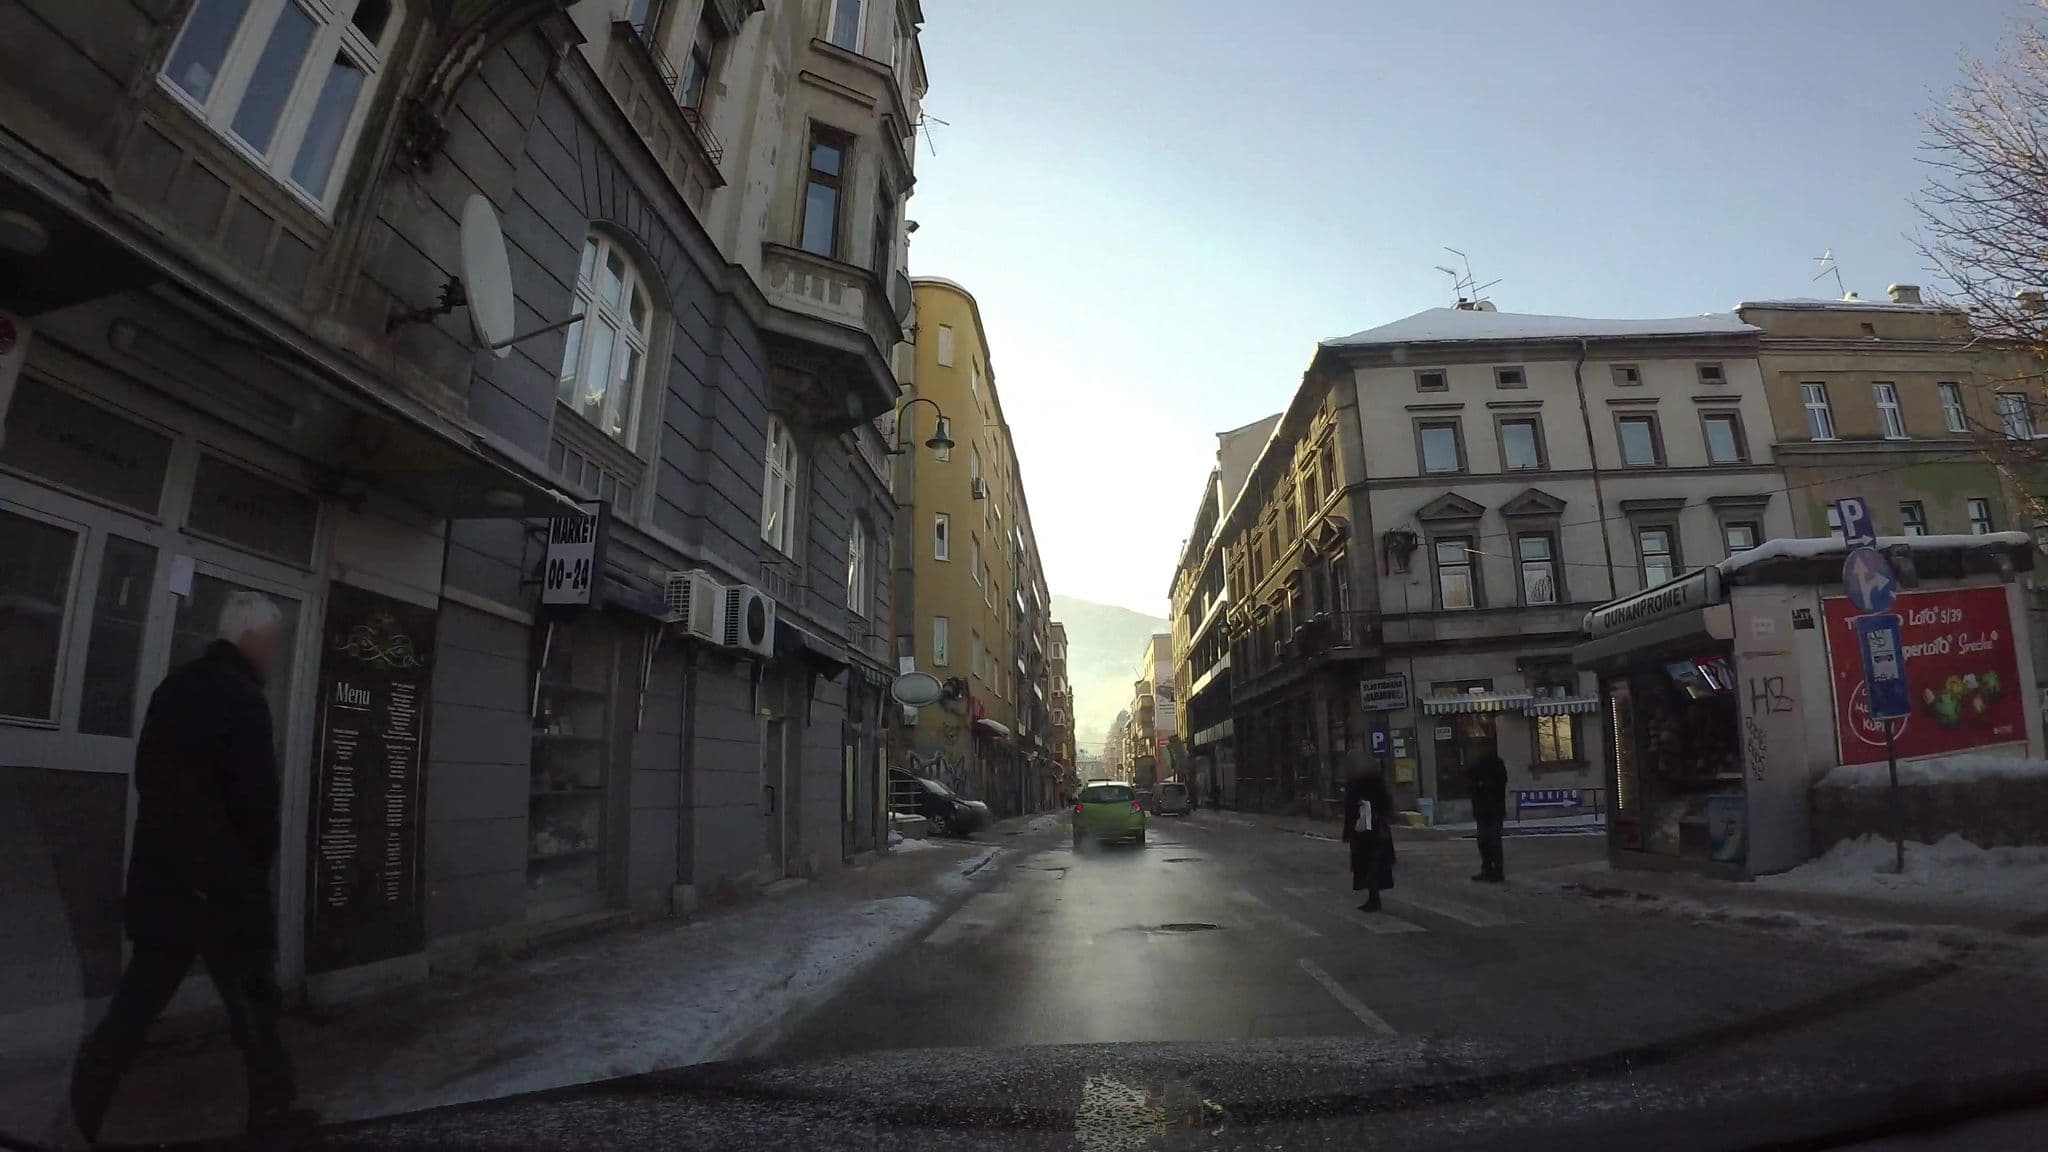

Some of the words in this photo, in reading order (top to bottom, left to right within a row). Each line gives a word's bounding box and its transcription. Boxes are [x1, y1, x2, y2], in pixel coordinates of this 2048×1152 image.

[551, 515, 597, 544] MARKET
[1840, 499, 1864, 538] P
[336, 681, 371, 705] Menu
[1372, 731, 1385, 750] P
